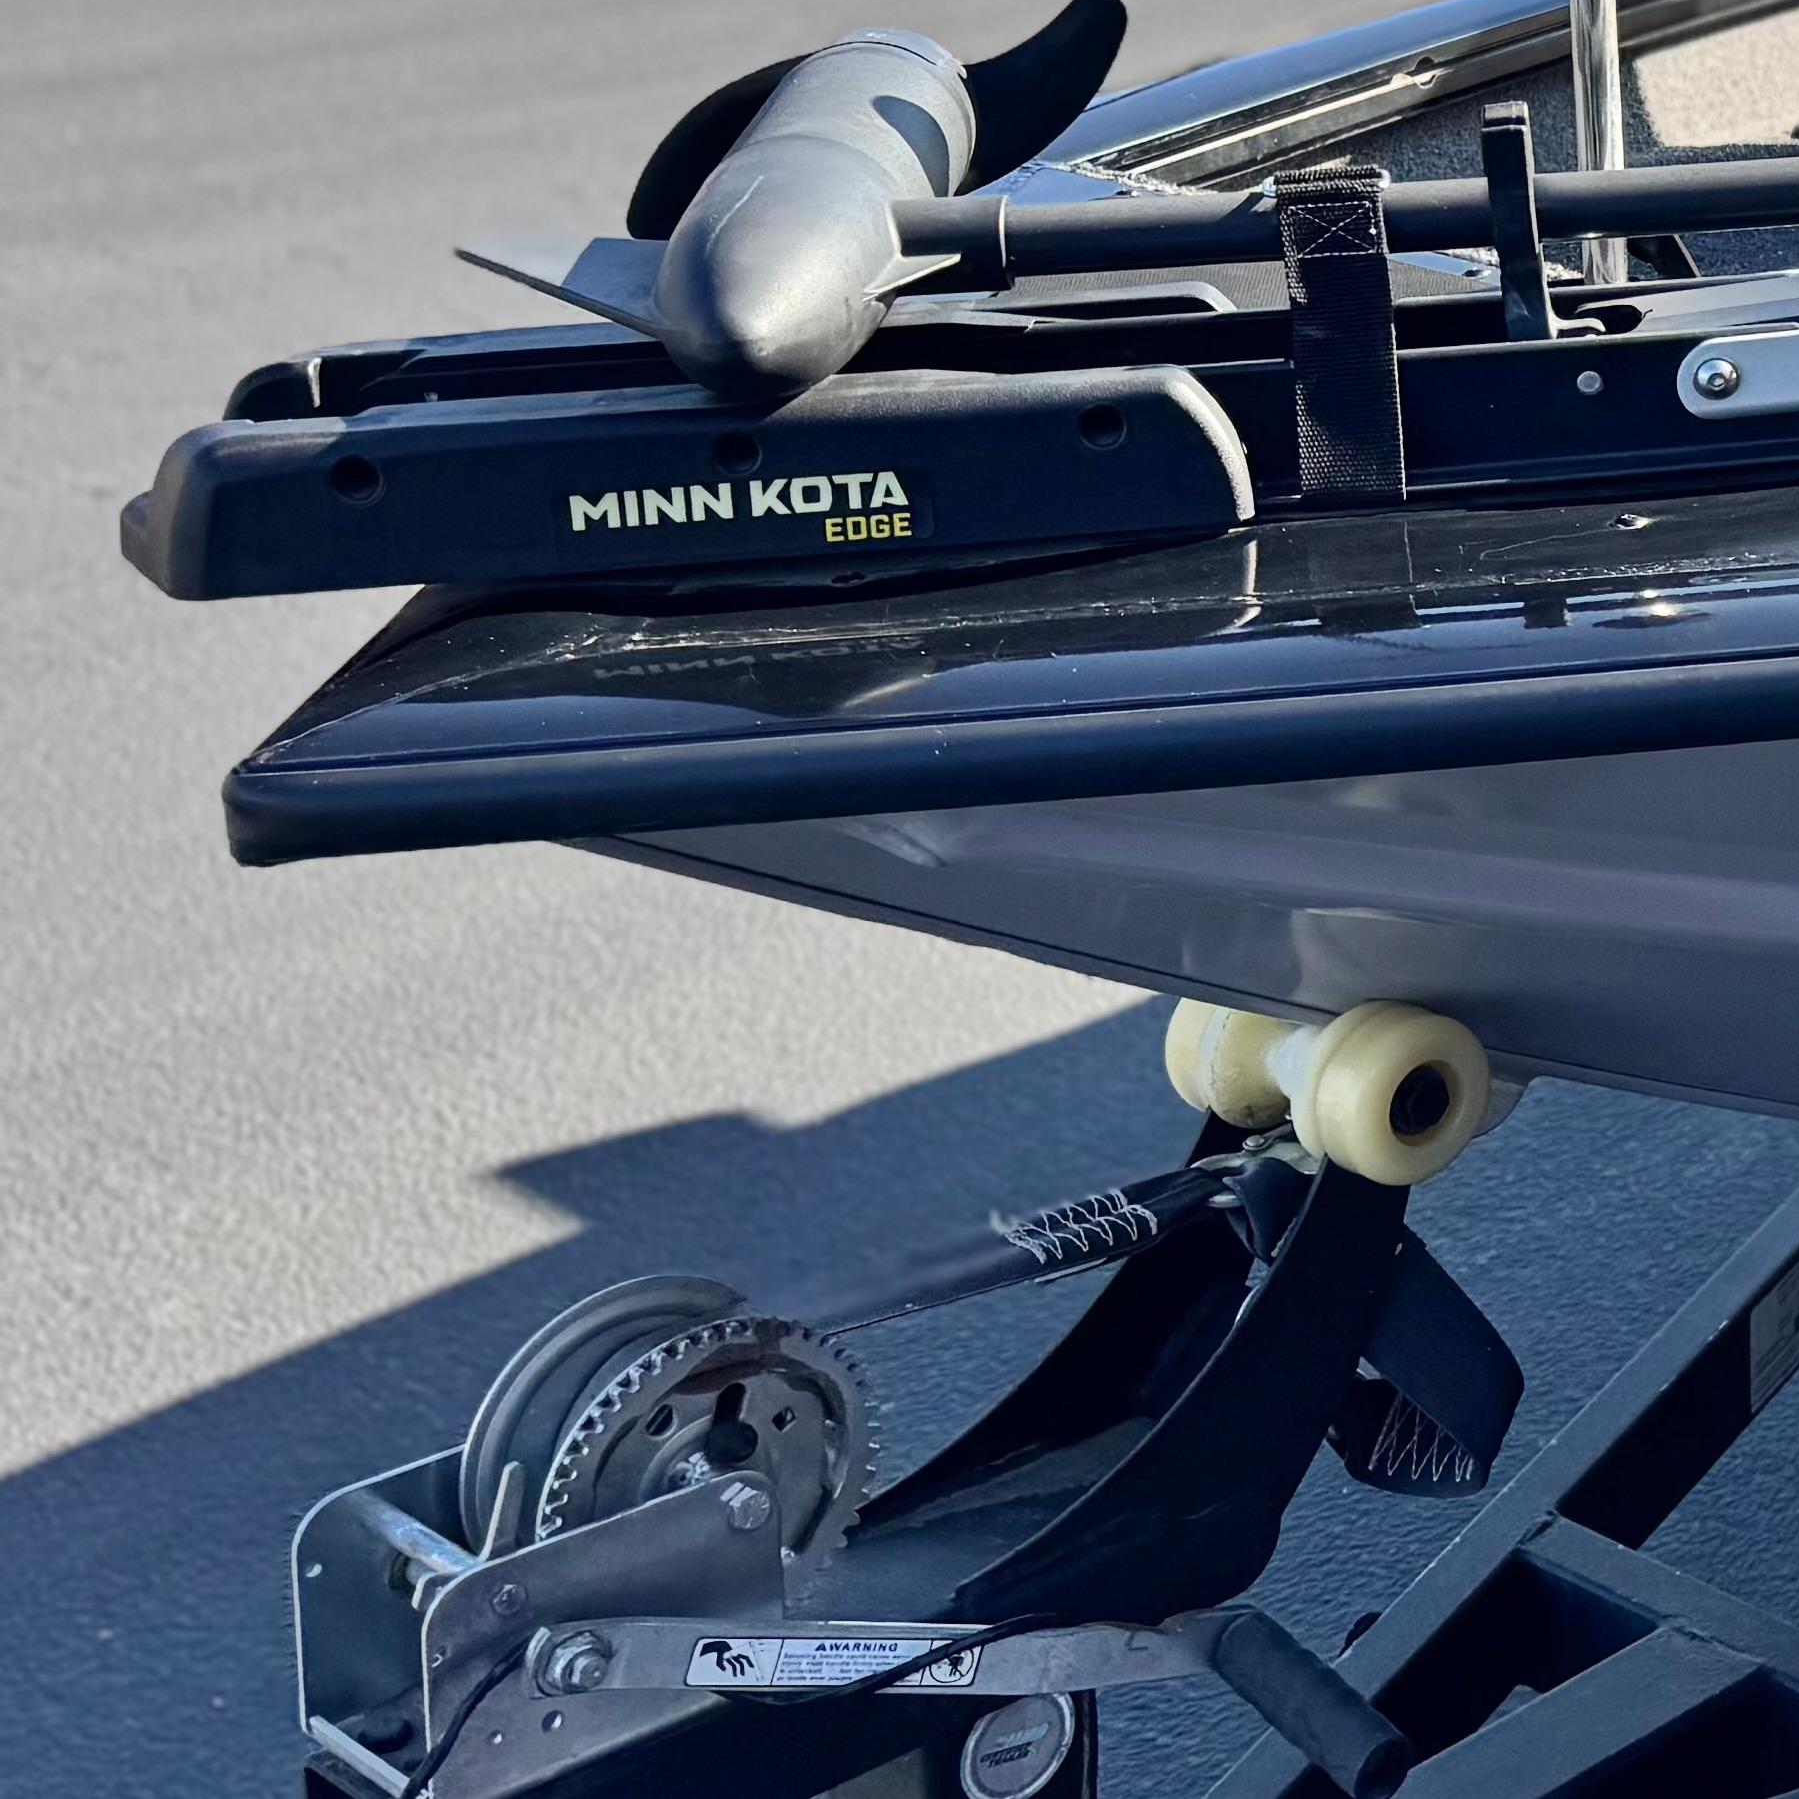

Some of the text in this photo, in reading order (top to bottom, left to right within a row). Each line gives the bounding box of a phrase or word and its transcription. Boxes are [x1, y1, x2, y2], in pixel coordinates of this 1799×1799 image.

[569, 471, 910, 531] MINN KOTA
[825, 512, 912, 542] EDGE
[830, 1642, 898, 1652] WARNING
